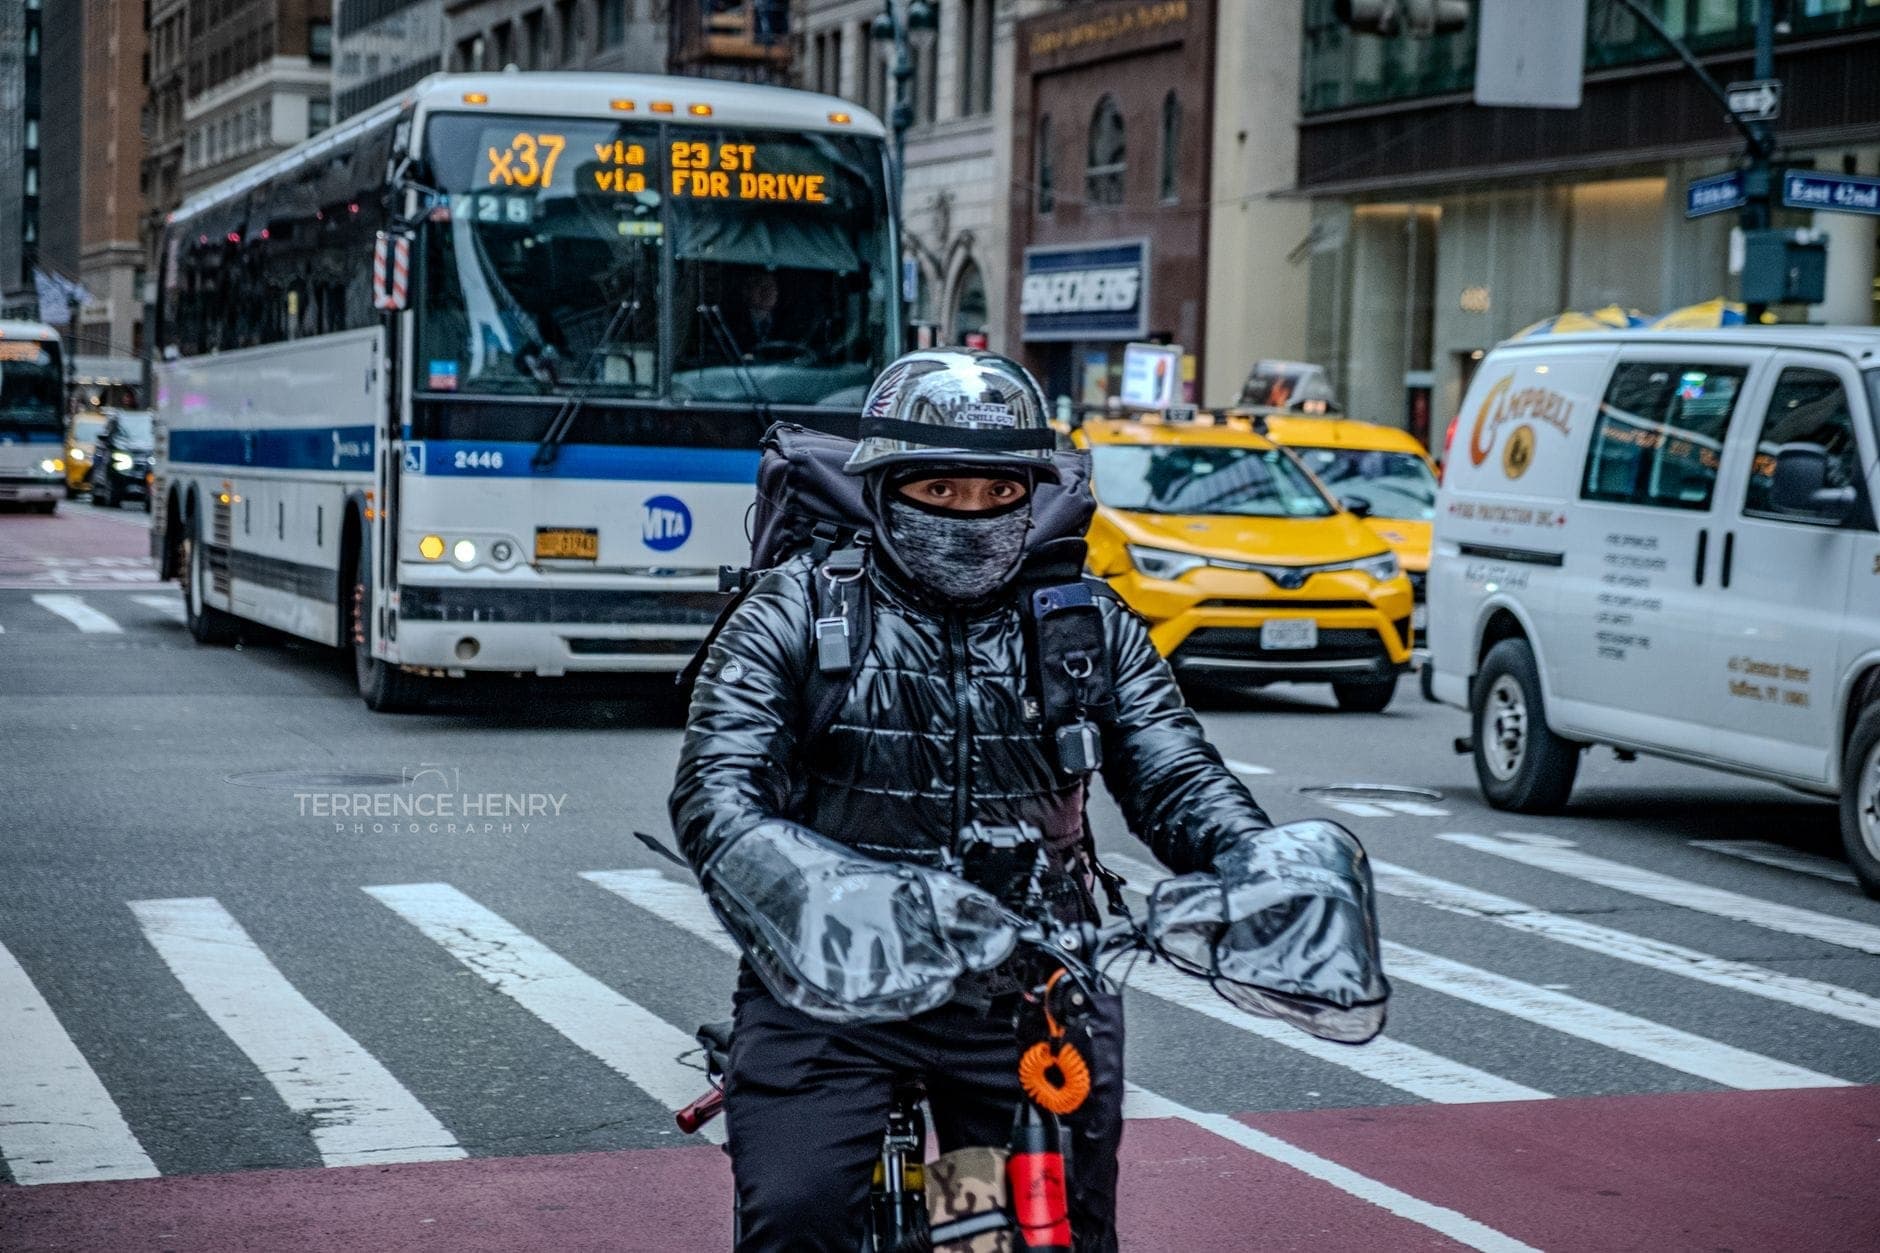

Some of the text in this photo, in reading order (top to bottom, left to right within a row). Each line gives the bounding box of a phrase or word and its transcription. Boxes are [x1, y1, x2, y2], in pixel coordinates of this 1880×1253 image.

[488, 132, 566, 188] x37
[594, 140, 756, 172] via 23 ST
[594, 170, 826, 202] via FDR DRIVE
[1789, 178, 1832, 204] East
[1019, 267, 1140, 315] SKECHERS
[957, 413, 965, 422] A
[966, 413, 994, 423] CHILL
[984, 404, 1006, 414] JUST
[454, 450, 504, 469] 2446
[642, 505, 686, 542] MTA
